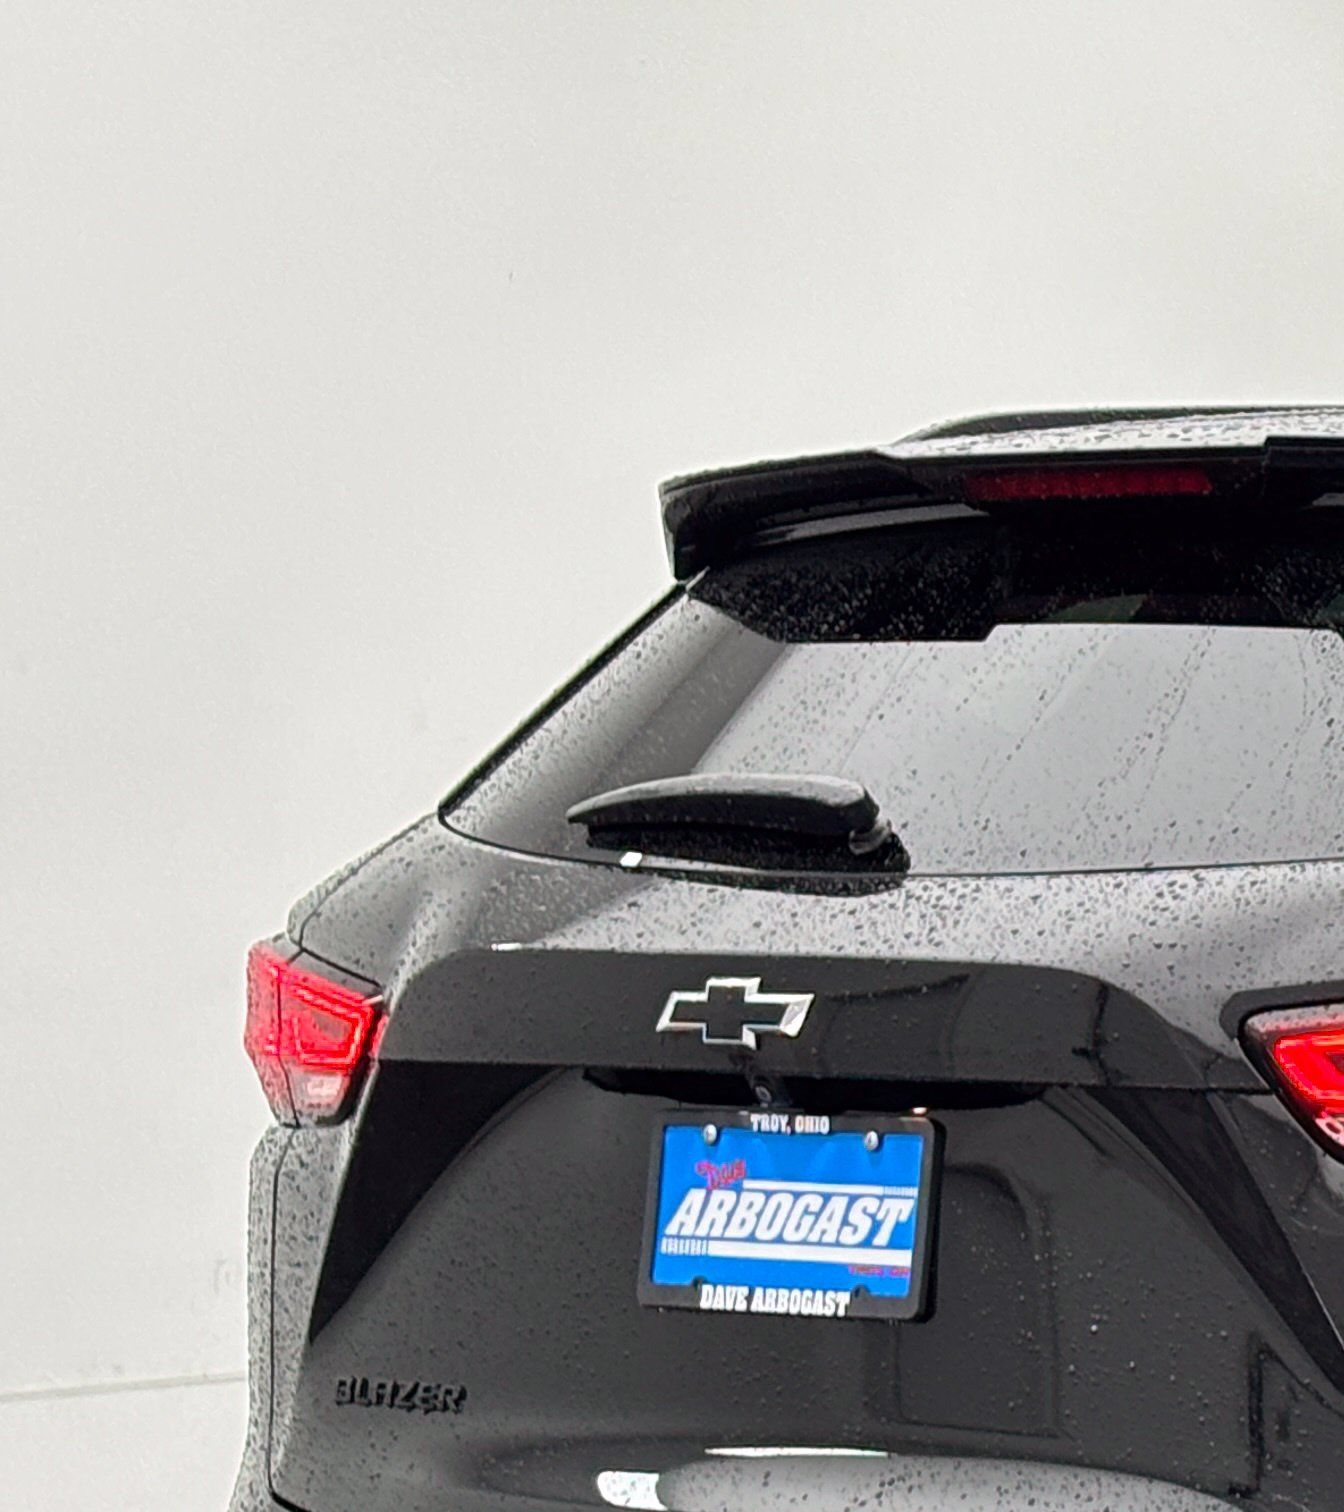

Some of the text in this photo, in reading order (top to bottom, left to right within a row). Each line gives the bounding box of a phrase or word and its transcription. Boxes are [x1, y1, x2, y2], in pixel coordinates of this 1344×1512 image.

[751, 1113, 831, 1135] TROY, OHIO
[665, 1188, 915, 1246] ARBOGAST
[700, 1284, 852, 1317] DAVE ARBOGAST
[336, 1376, 467, 1415] BLAZER
